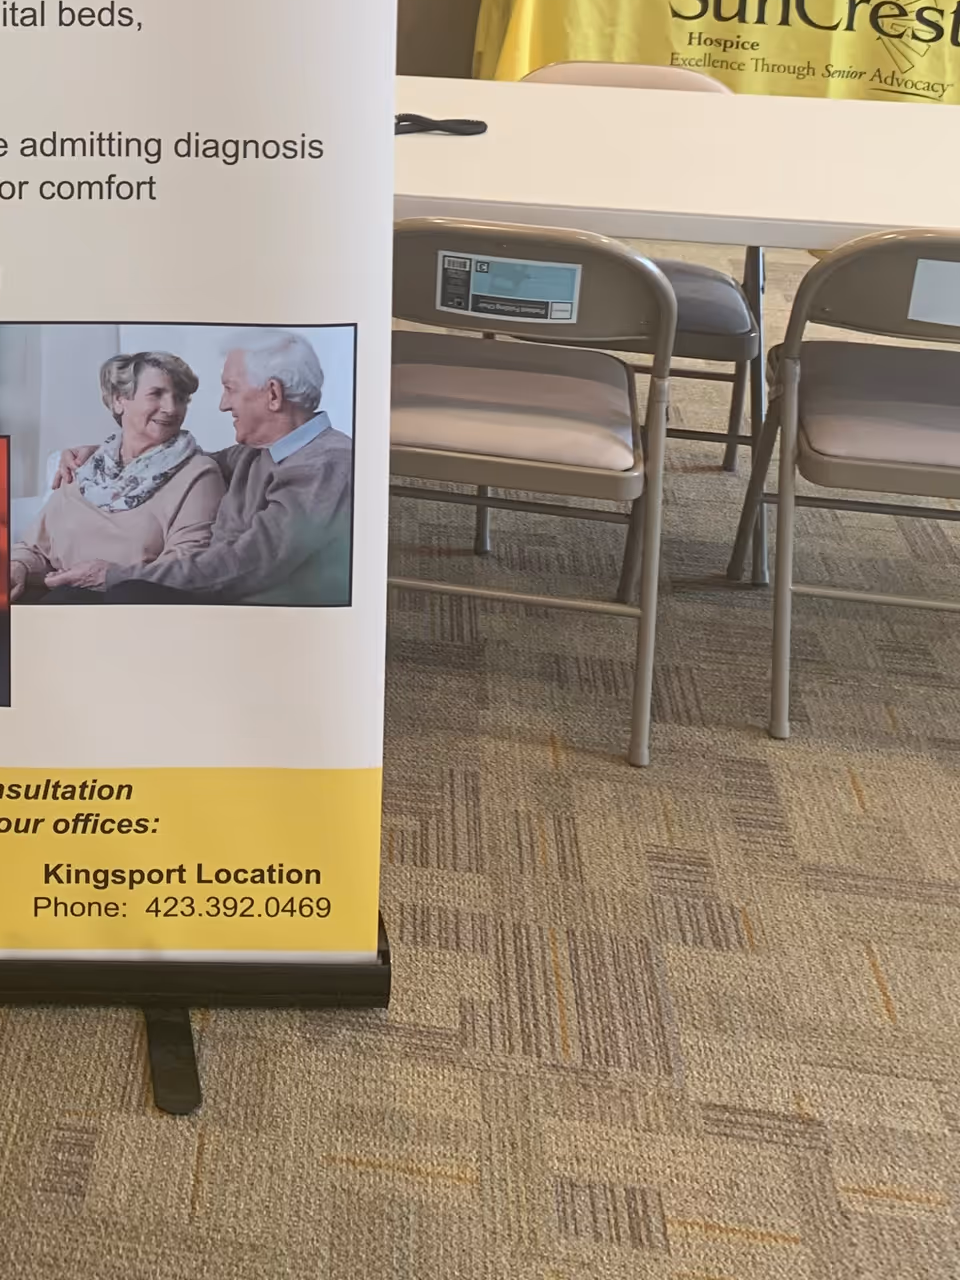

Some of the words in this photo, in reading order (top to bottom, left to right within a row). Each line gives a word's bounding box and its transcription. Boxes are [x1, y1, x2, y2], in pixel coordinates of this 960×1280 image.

[59, 1, 141, 31] beds,
[687, 32, 760, 51] Hospice
[669, 52, 746, 72] Excellence
[750, 57, 816, 80] Through
[821, 65, 867, 81] Senior
[20, 131, 161, 164] admitting
[174, 132, 323, 165] diagnosis
[40, 174, 156, 200] comfort
[53, 813, 159, 834] offices:
[45, 864, 186, 890] Kingsport
[197, 864, 320, 884] Location
[34, 897, 126, 917] Phone:
[146, 896, 330, 918] 423.392.0469
